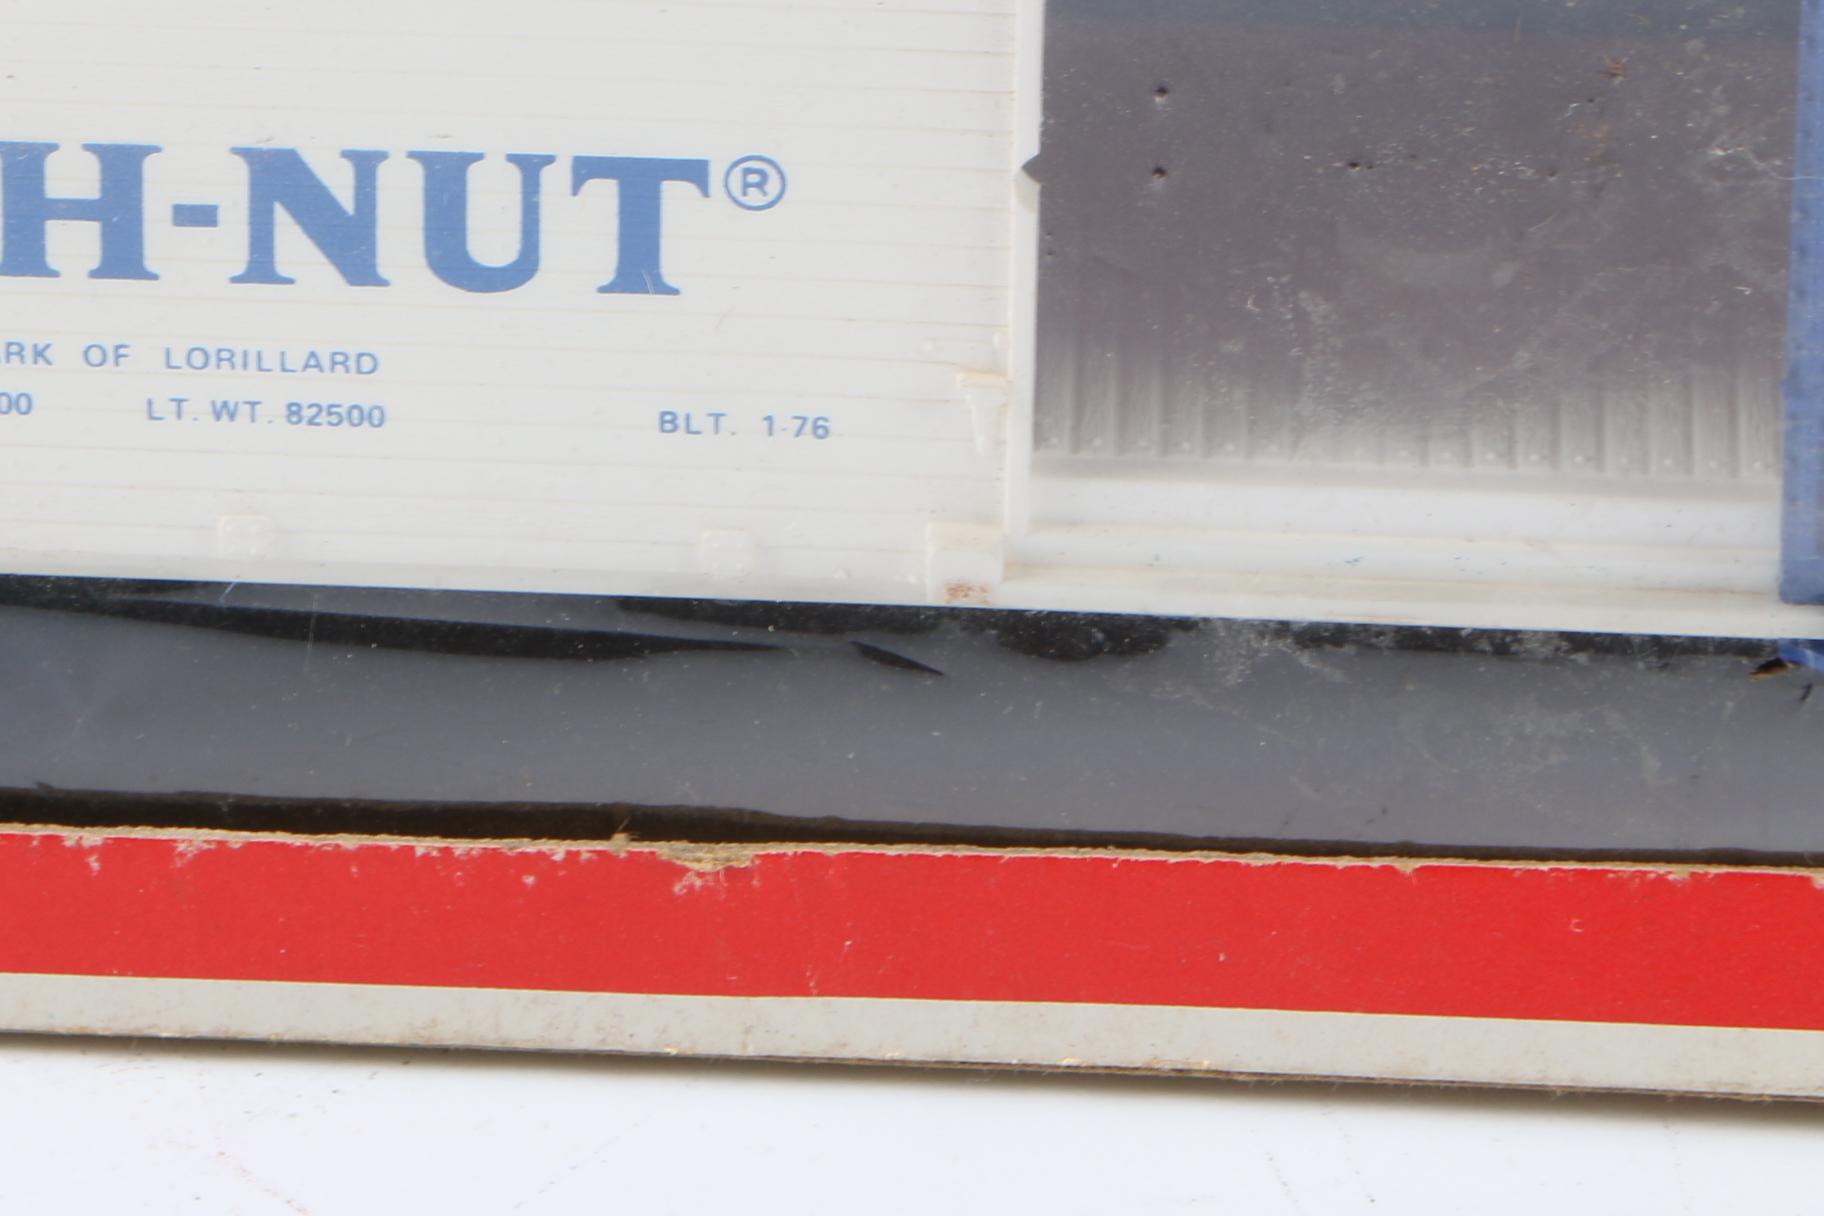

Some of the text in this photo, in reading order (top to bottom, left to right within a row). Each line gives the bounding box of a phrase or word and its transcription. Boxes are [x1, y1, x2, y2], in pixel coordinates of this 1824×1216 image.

[82, 342, 132, 368] OF
[163, 345, 381, 375] LORILLARD
[145, 397, 387, 429] LT. WT. 82500
[656, 409, 738, 437] BLT.
